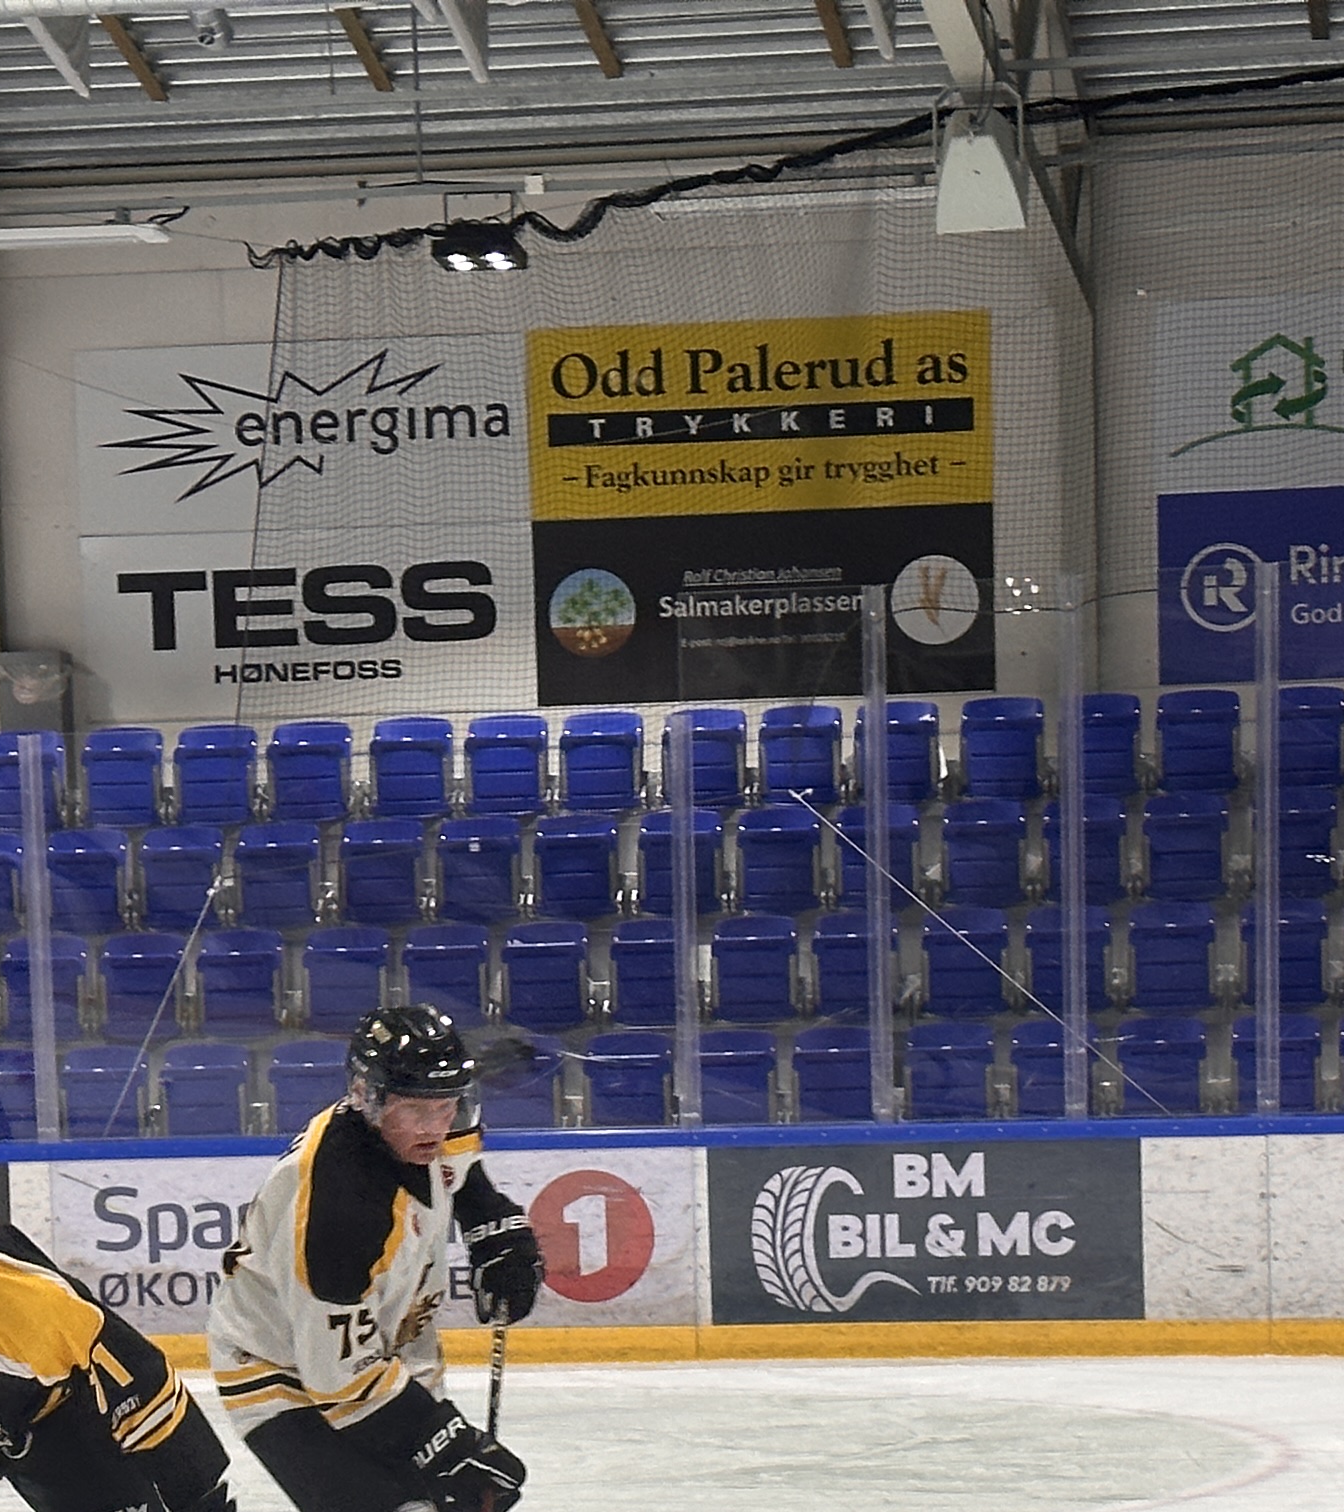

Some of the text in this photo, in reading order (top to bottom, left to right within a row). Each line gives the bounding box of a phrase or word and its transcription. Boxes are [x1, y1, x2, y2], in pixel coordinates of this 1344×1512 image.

[552, 338, 968, 399] Odd Palerud as
[234, 401, 511, 454] energima
[588, 405, 934, 439] TRYKKERI
[777, 457, 815, 485] gir
[824, 450, 940, 484] trygghet
[117, 560, 497, 651] TESS
[1290, 602, 1342, 625] God
[214, 659, 402, 684] HØNEFOSS
[893, 1152, 986, 1198] BM
[828, 1210, 1076, 1258] BIL & MC
[964, 1275, 1003, 1293] 909
[1007, 1275, 1032, 1293] 82
[1036, 1275, 1072, 1293] 879
[328, 1309, 379, 1361] 75
